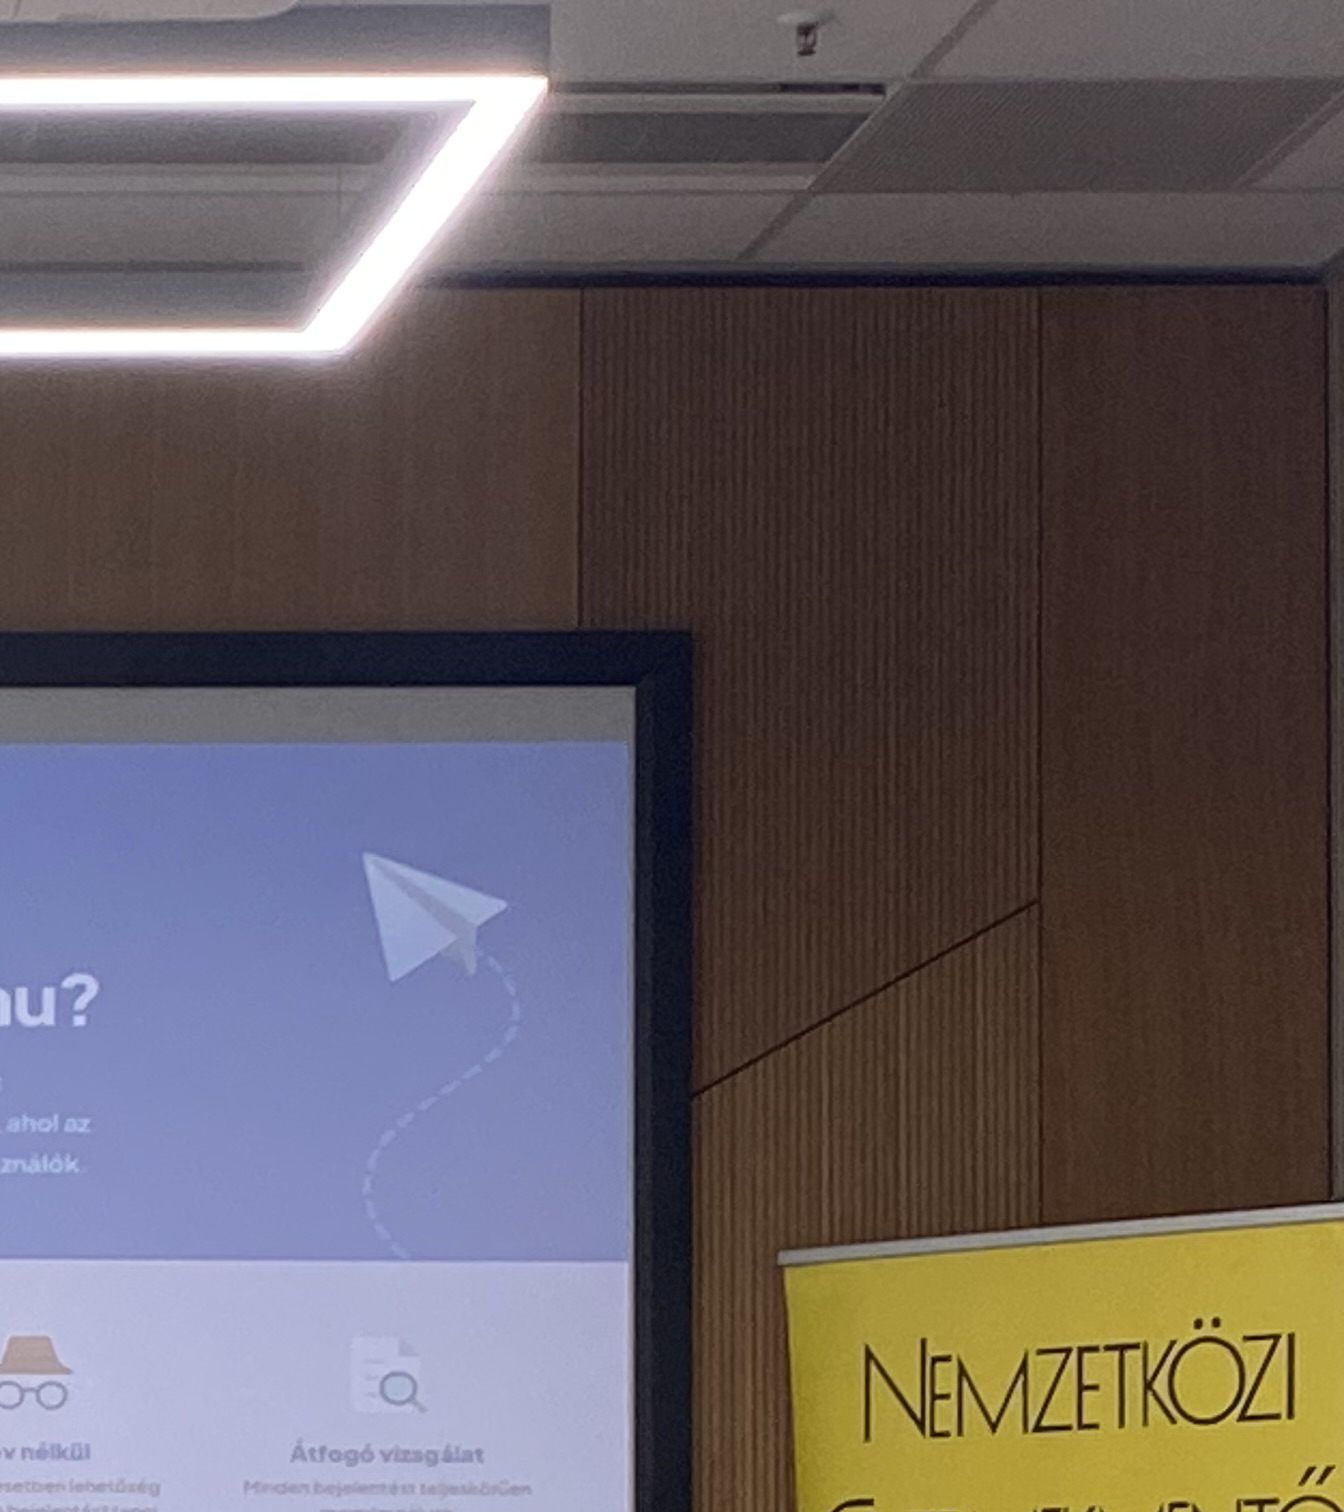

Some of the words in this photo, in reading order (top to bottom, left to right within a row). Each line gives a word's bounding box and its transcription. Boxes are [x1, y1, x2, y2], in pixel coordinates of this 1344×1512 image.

[7, 1113, 60, 1134] ahol
[64, 1117, 92, 1134] az
[863, 1316, 1296, 1443] NEMZETKÖZI
[20, 1442, 92, 1462] nélkül
[289, 1437, 375, 1467] Átfogó
[379, 1443, 485, 1467] vizsgálat
